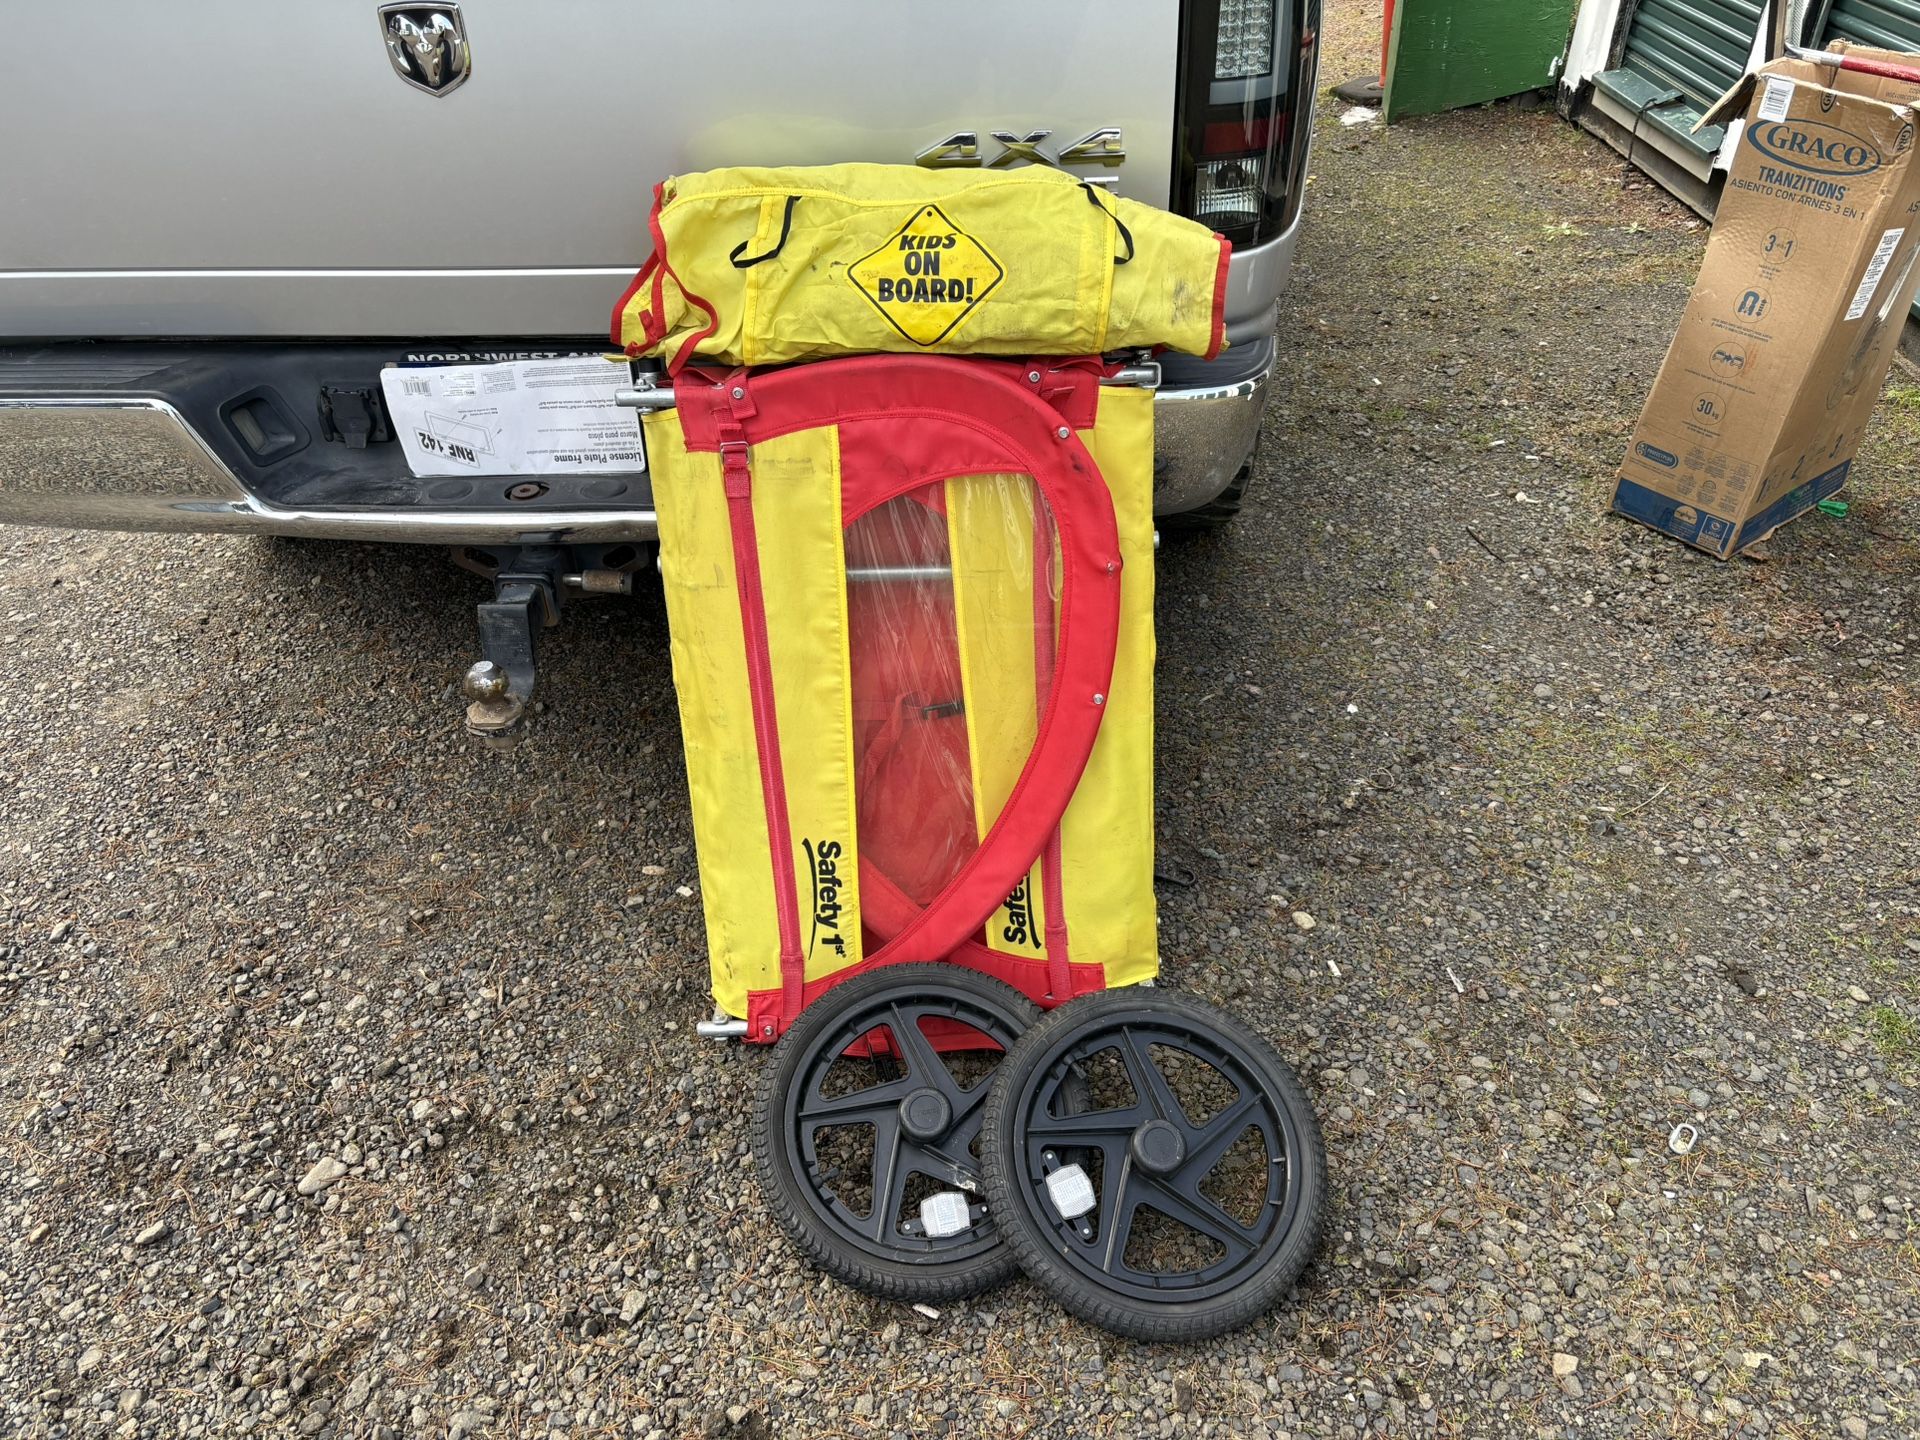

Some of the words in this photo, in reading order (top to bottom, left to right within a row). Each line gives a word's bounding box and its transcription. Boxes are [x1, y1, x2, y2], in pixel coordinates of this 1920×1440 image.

[915, 127, 1125, 168] 4X4
[1767, 126, 1867, 167] GRACO
[1758, 165, 1846, 201] TRANZITIONS
[1730, 178, 1773, 196] ASIENTO
[1775, 189, 1797, 202] CON
[1833, 204, 1841, 214] 3
[1842, 207, 1857, 219] EN
[1859, 211, 1865, 221] 1
[899, 233, 957, 250] KIDS
[904, 251, 940, 276] ON
[878, 277, 974, 304] BOARD!
[1697, 399, 1713, 415] 30
[418, 431, 444, 453] 142
[554, 453, 583, 464] Frame
[584, 453, 608, 464] Plate
[609, 452, 642, 463] License
[815, 840, 842, 930] Safety
[1002, 871, 1028, 945] Safe
